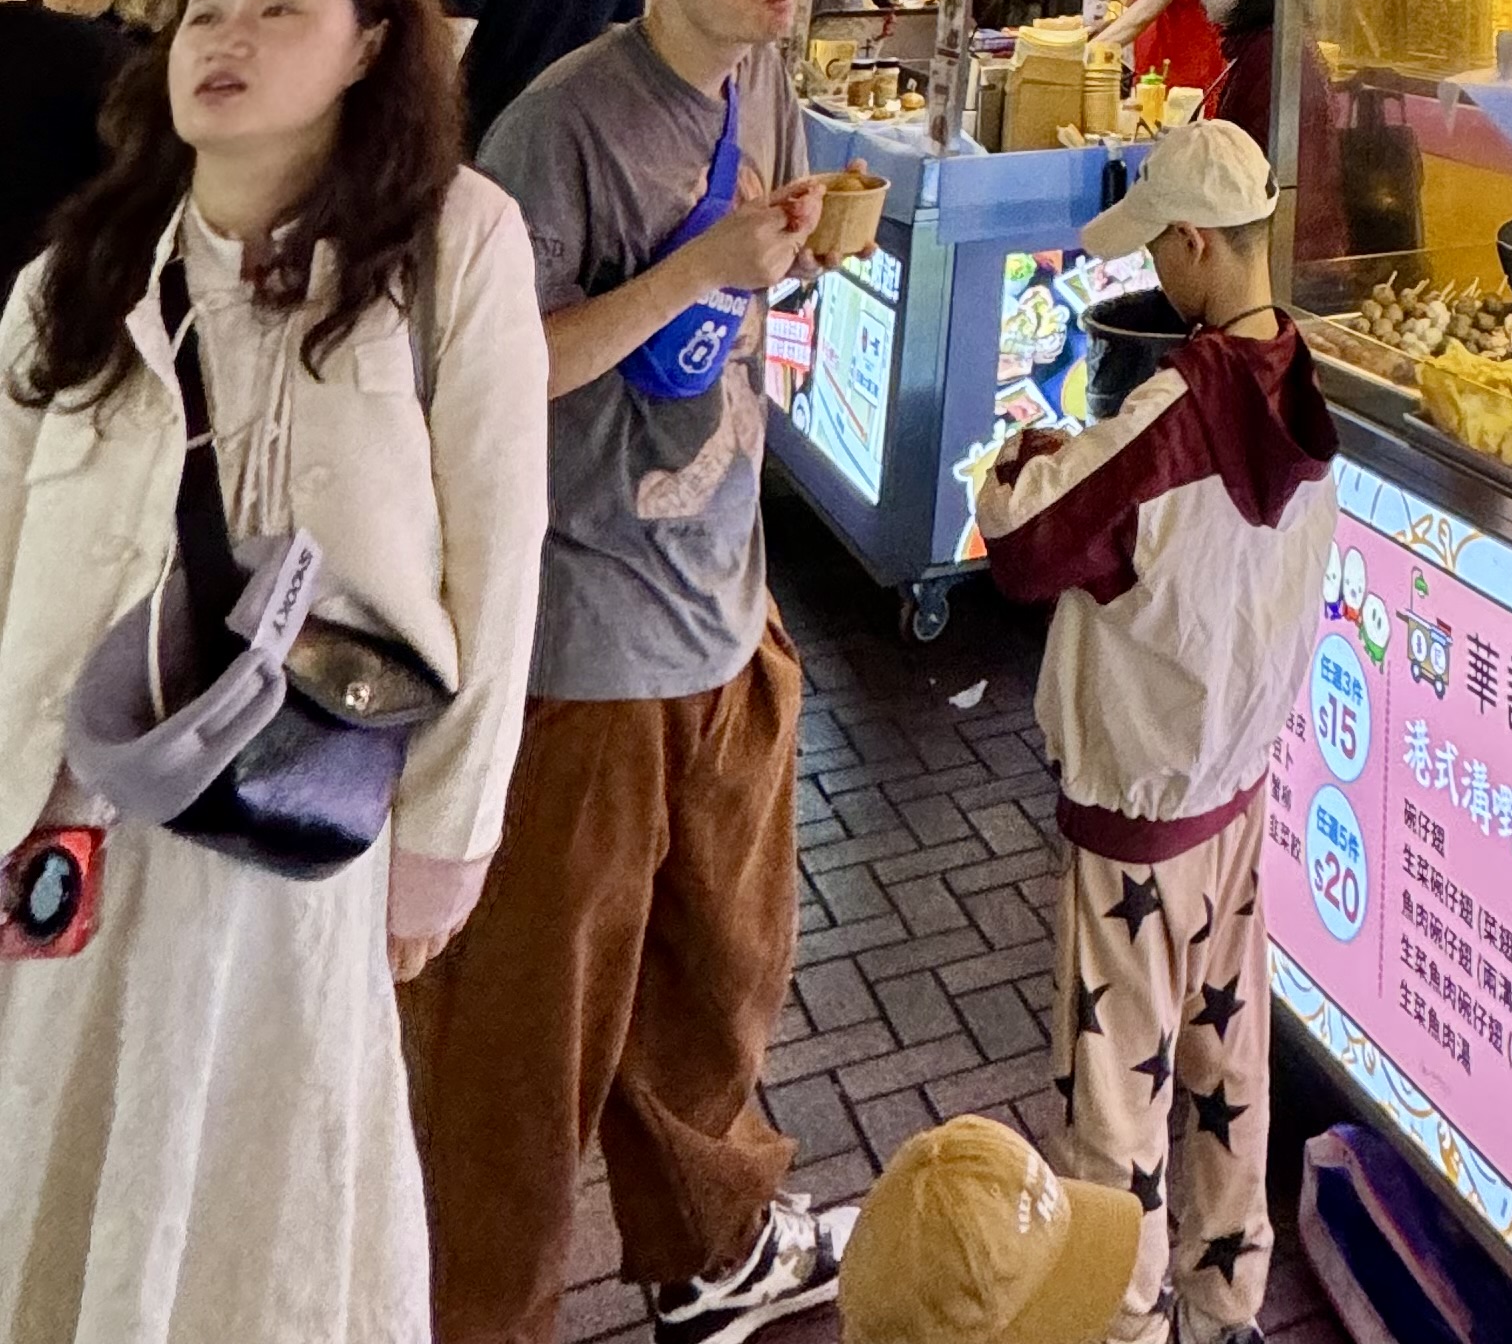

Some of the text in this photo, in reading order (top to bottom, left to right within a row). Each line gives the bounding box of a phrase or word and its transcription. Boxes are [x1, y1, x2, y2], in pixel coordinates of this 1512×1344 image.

[1320, 654, 1364, 707] 任選3件
[1318, 692, 1358, 760] $15
[1316, 805, 1360, 863] 任選5件
[1314, 850, 1361, 924] $20
